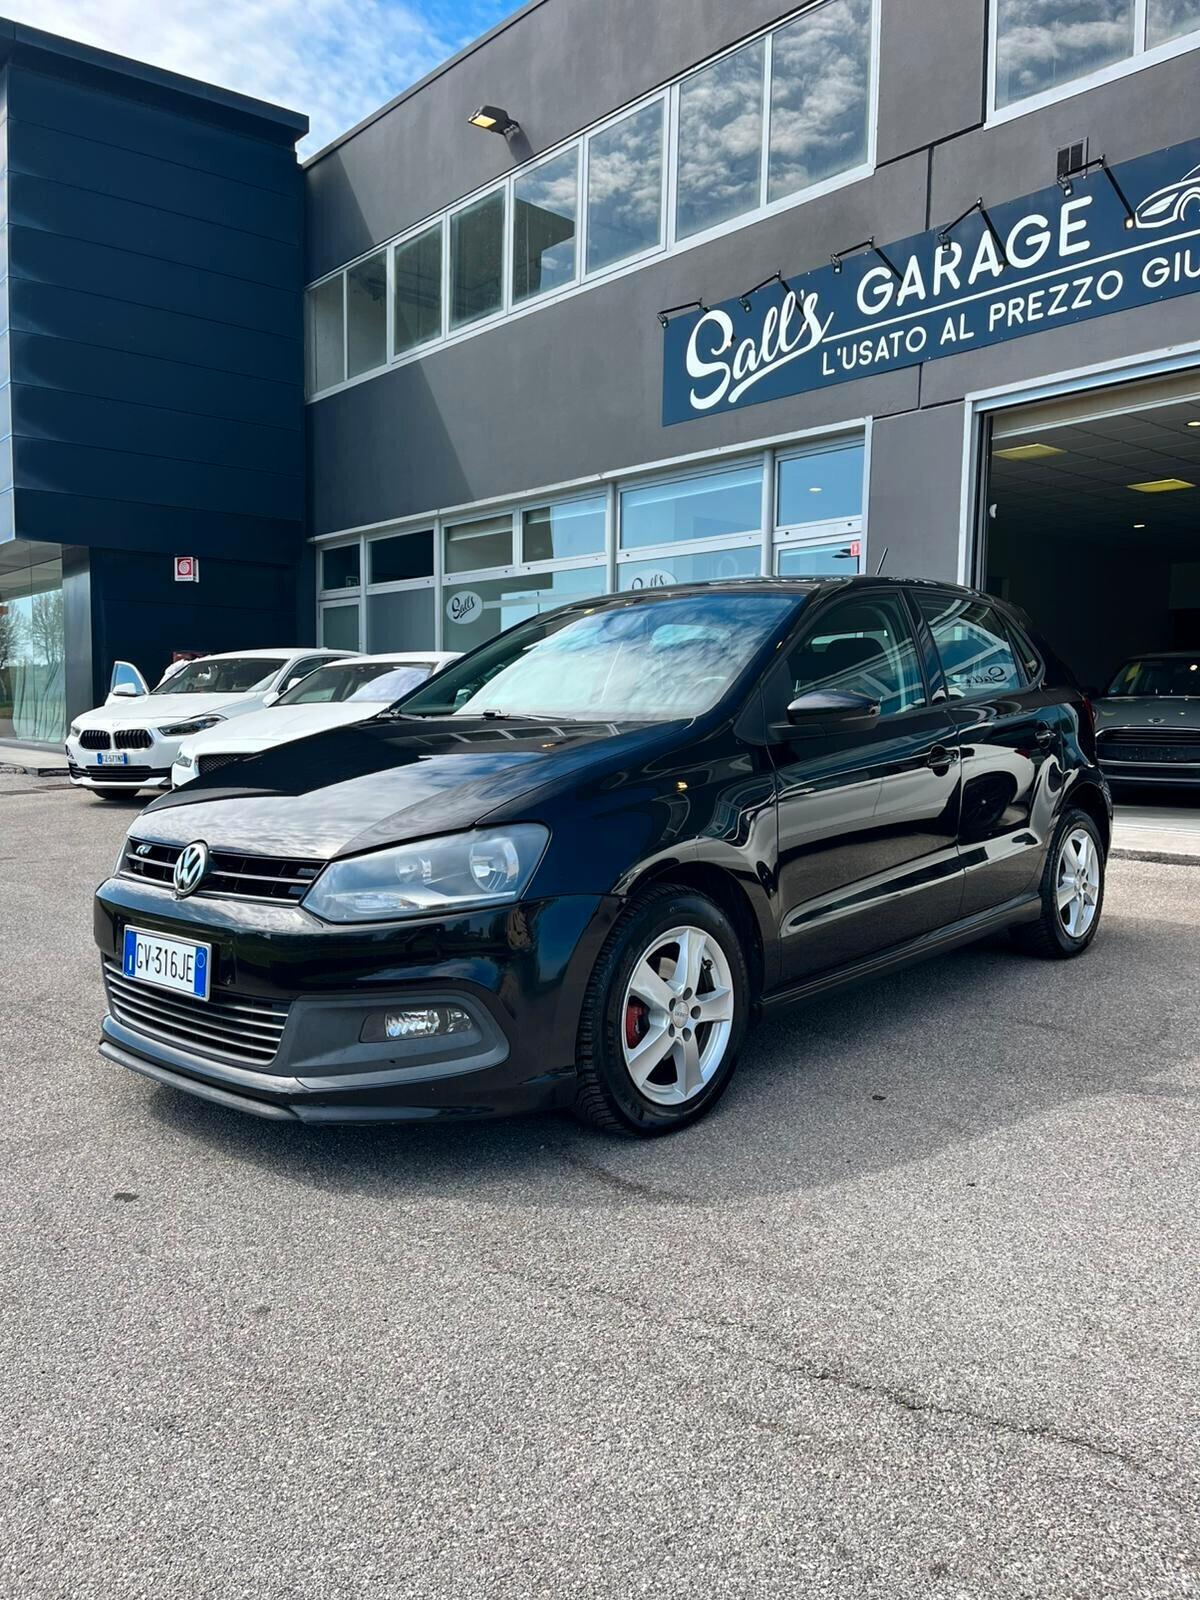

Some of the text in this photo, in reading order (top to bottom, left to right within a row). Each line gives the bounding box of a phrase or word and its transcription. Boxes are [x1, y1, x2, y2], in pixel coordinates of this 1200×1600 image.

[686, 195, 1093, 410] Sall's GARAGE
[822, 326, 927, 375] L'USATO
[940, 313, 974, 345] AL
[989, 270, 1124, 332] PREZZO
